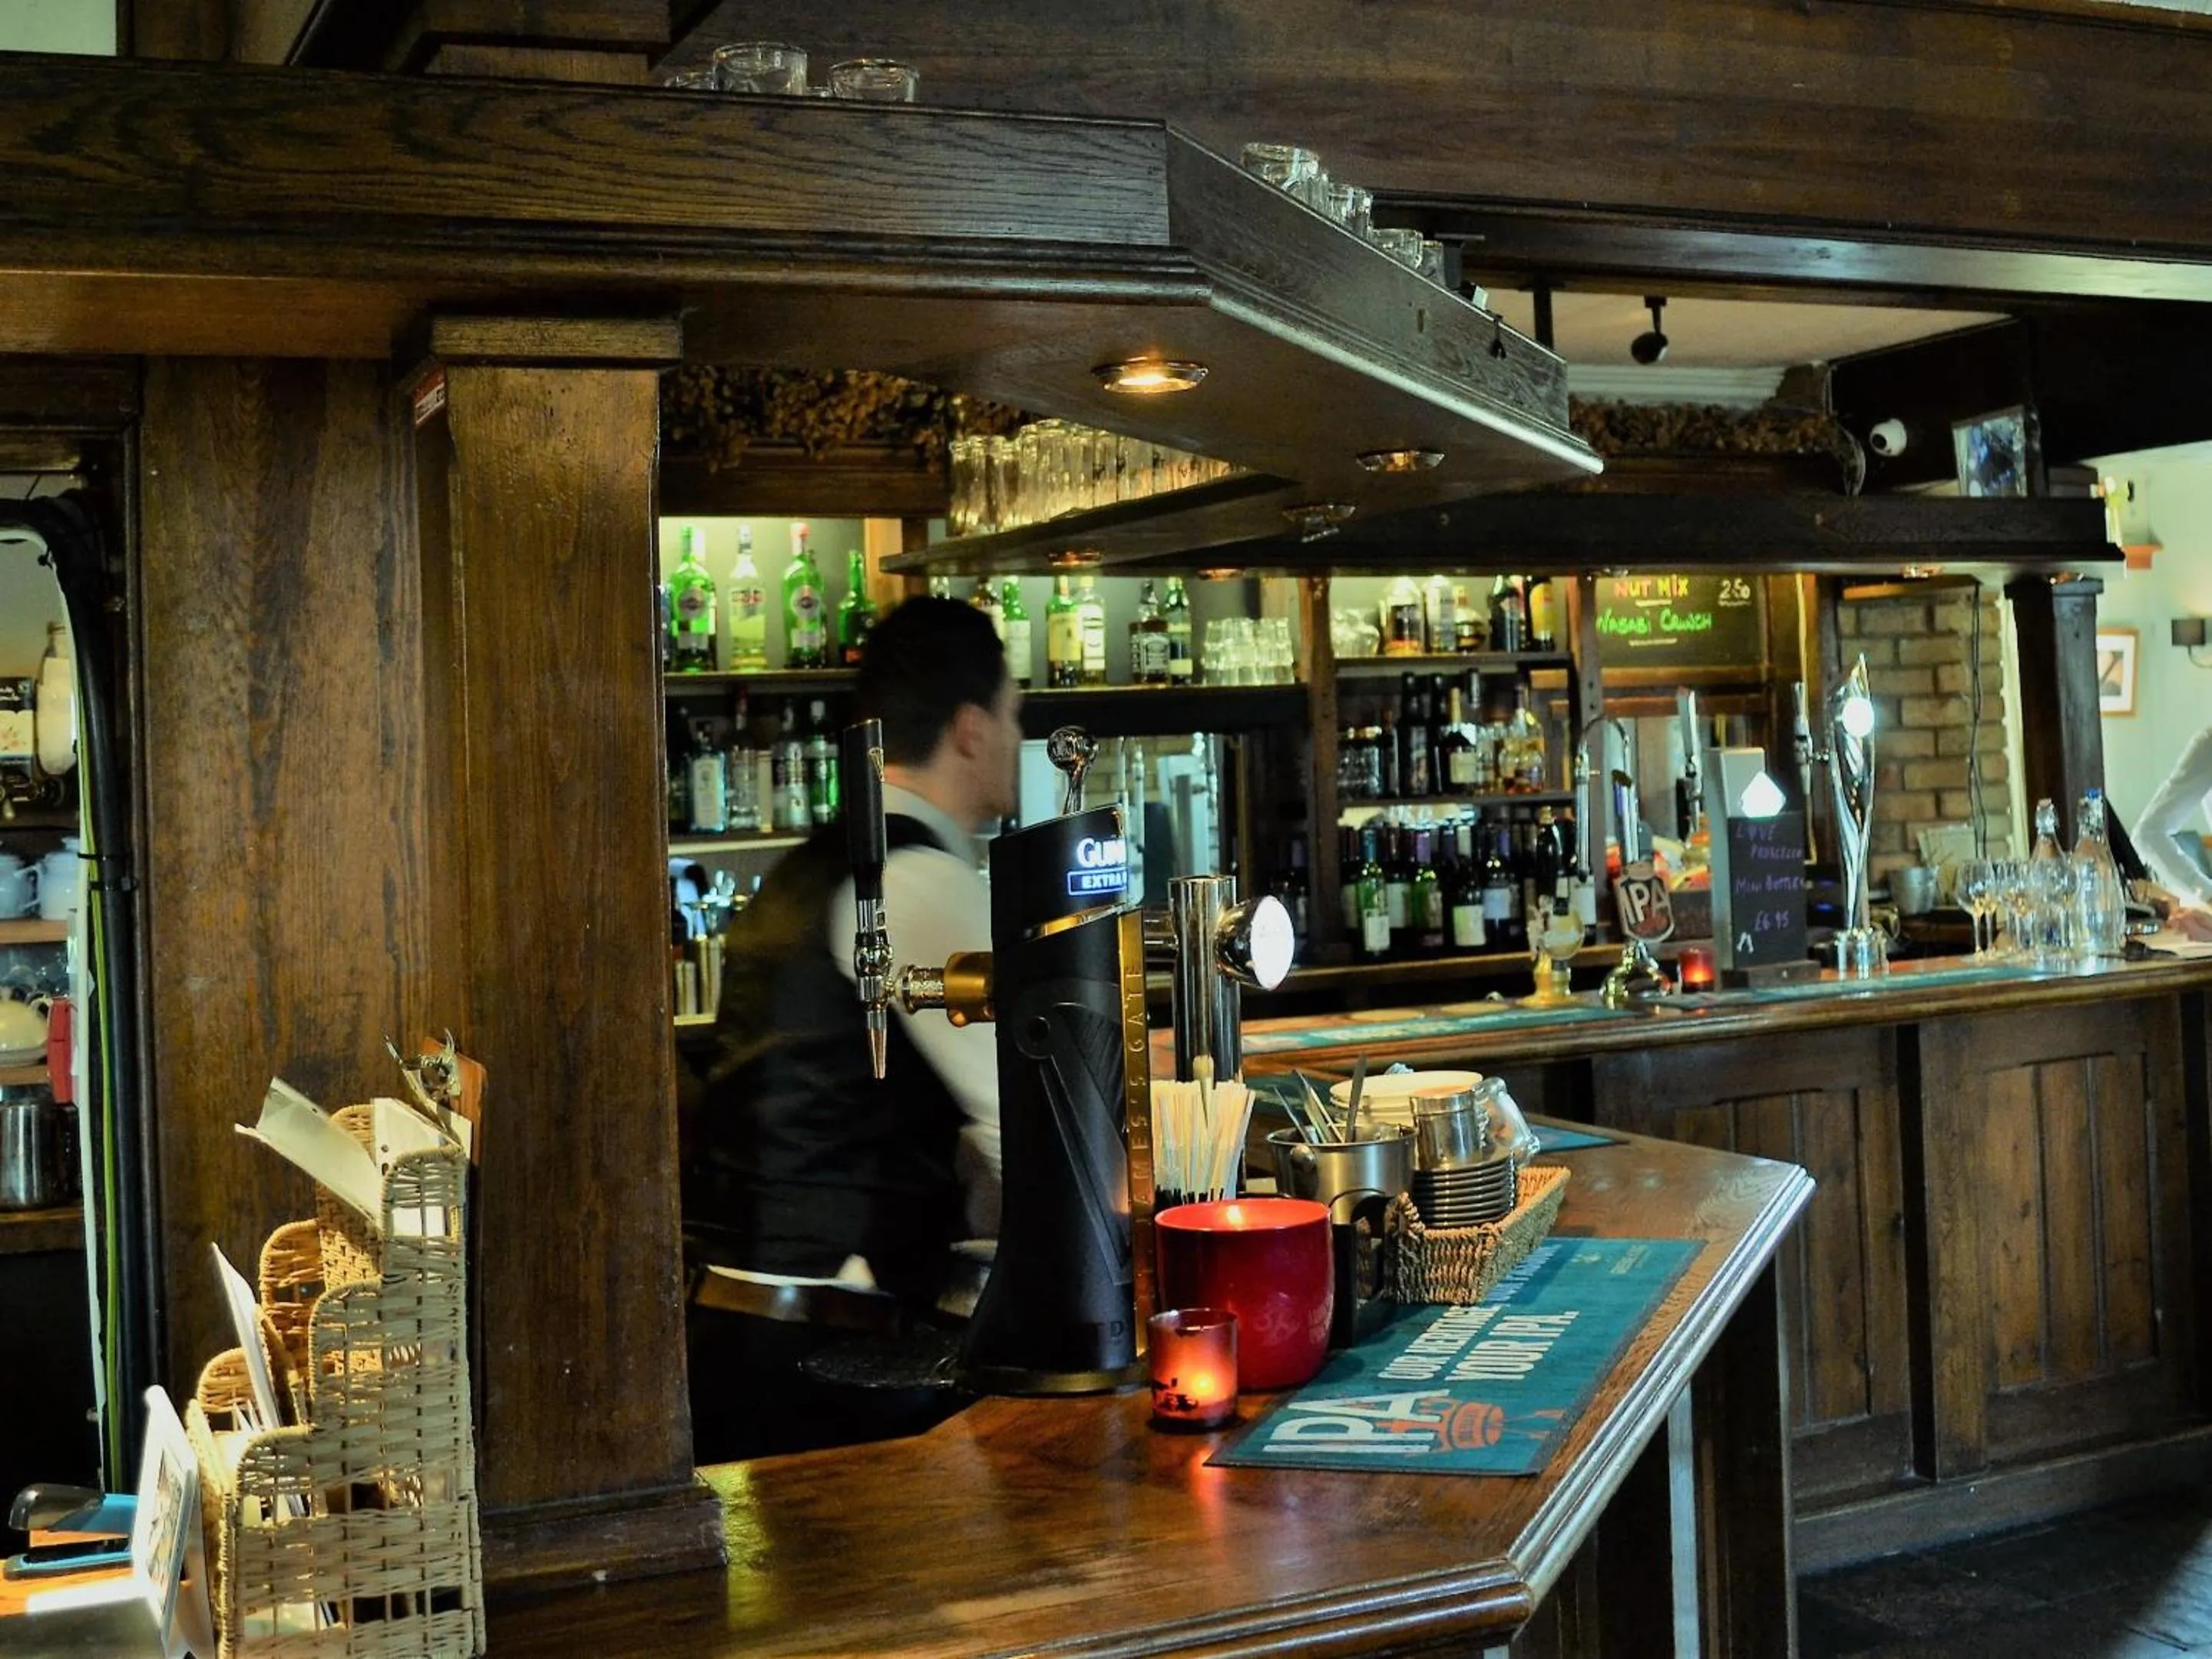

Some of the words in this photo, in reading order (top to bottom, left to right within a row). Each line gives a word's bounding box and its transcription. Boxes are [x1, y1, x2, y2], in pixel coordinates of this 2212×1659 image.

[1620, 879, 1668, 924] IPA
[1377, 1354, 1451, 1380] OUR
[1443, 1340, 1553, 1381] YOUR
[1262, 1389, 1450, 1453] IPA
